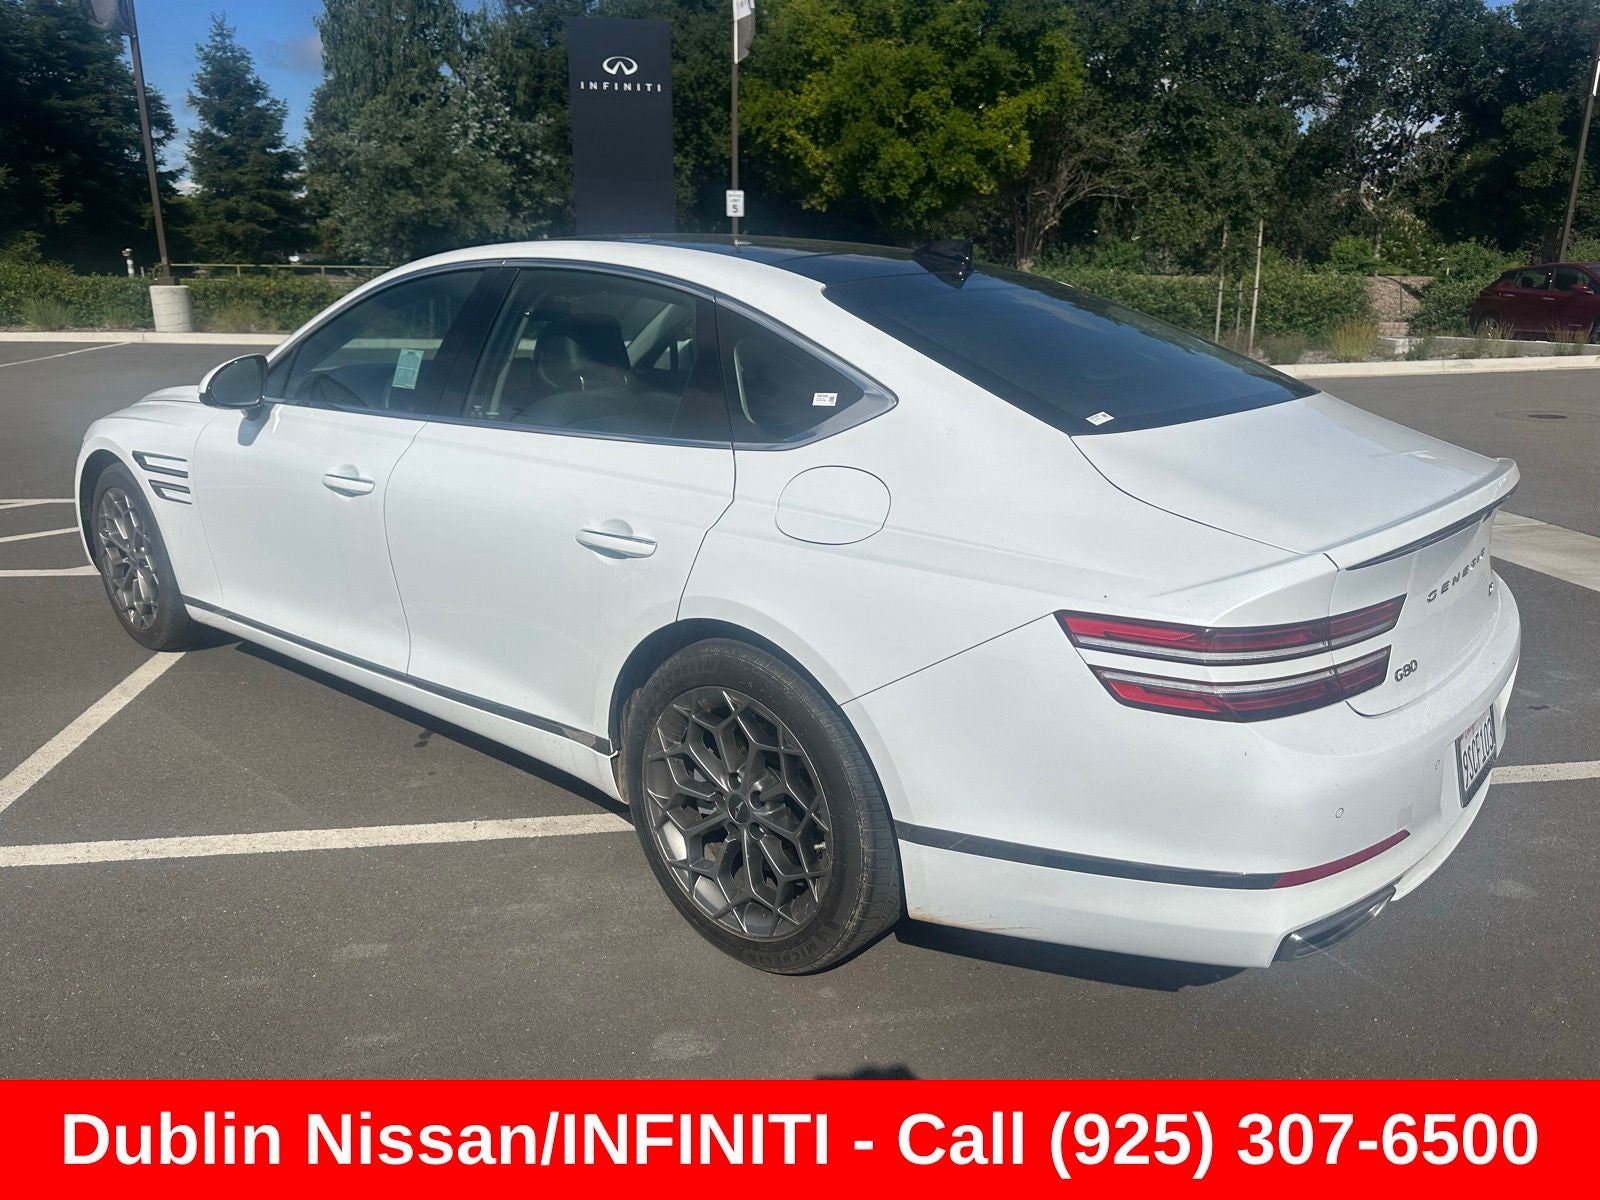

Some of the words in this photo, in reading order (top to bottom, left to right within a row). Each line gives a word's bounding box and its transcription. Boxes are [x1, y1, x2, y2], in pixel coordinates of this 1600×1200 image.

[580, 81, 662, 92] INFINITI
[731, 204, 739, 213] 5
[1394, 659, 1418, 682] G80
